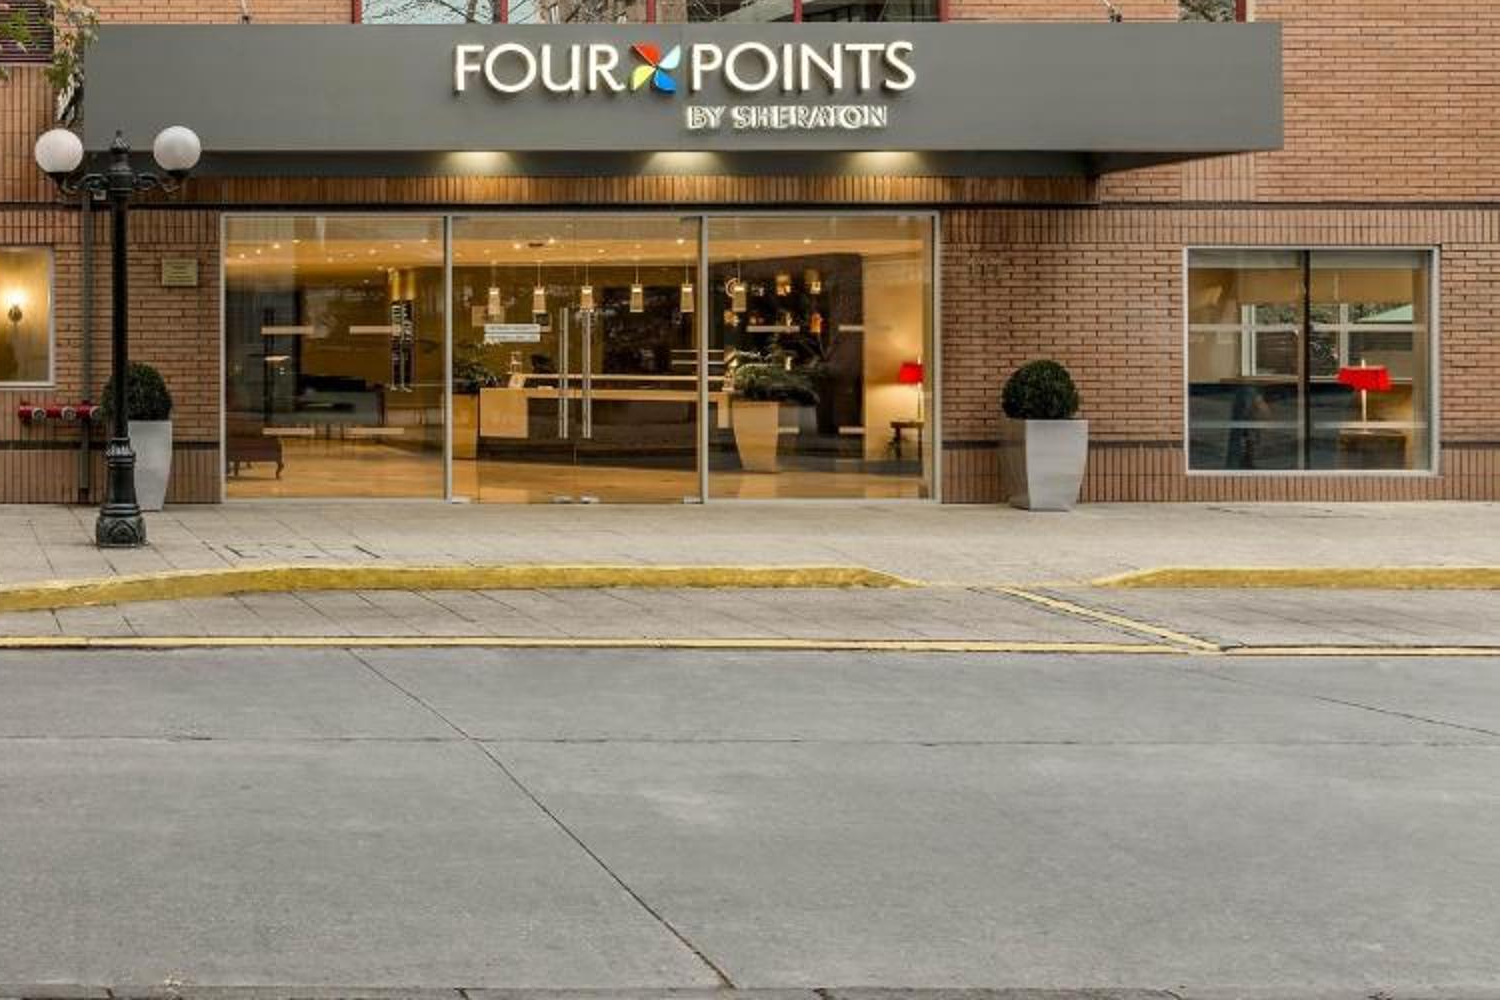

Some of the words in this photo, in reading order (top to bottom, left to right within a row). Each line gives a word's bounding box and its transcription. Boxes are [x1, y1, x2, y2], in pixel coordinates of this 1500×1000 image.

[455, 42, 624, 93] FOUR
[691, 40, 917, 92] POINTS
[686, 105, 725, 129] BY
[731, 105, 887, 129] SHERATON
